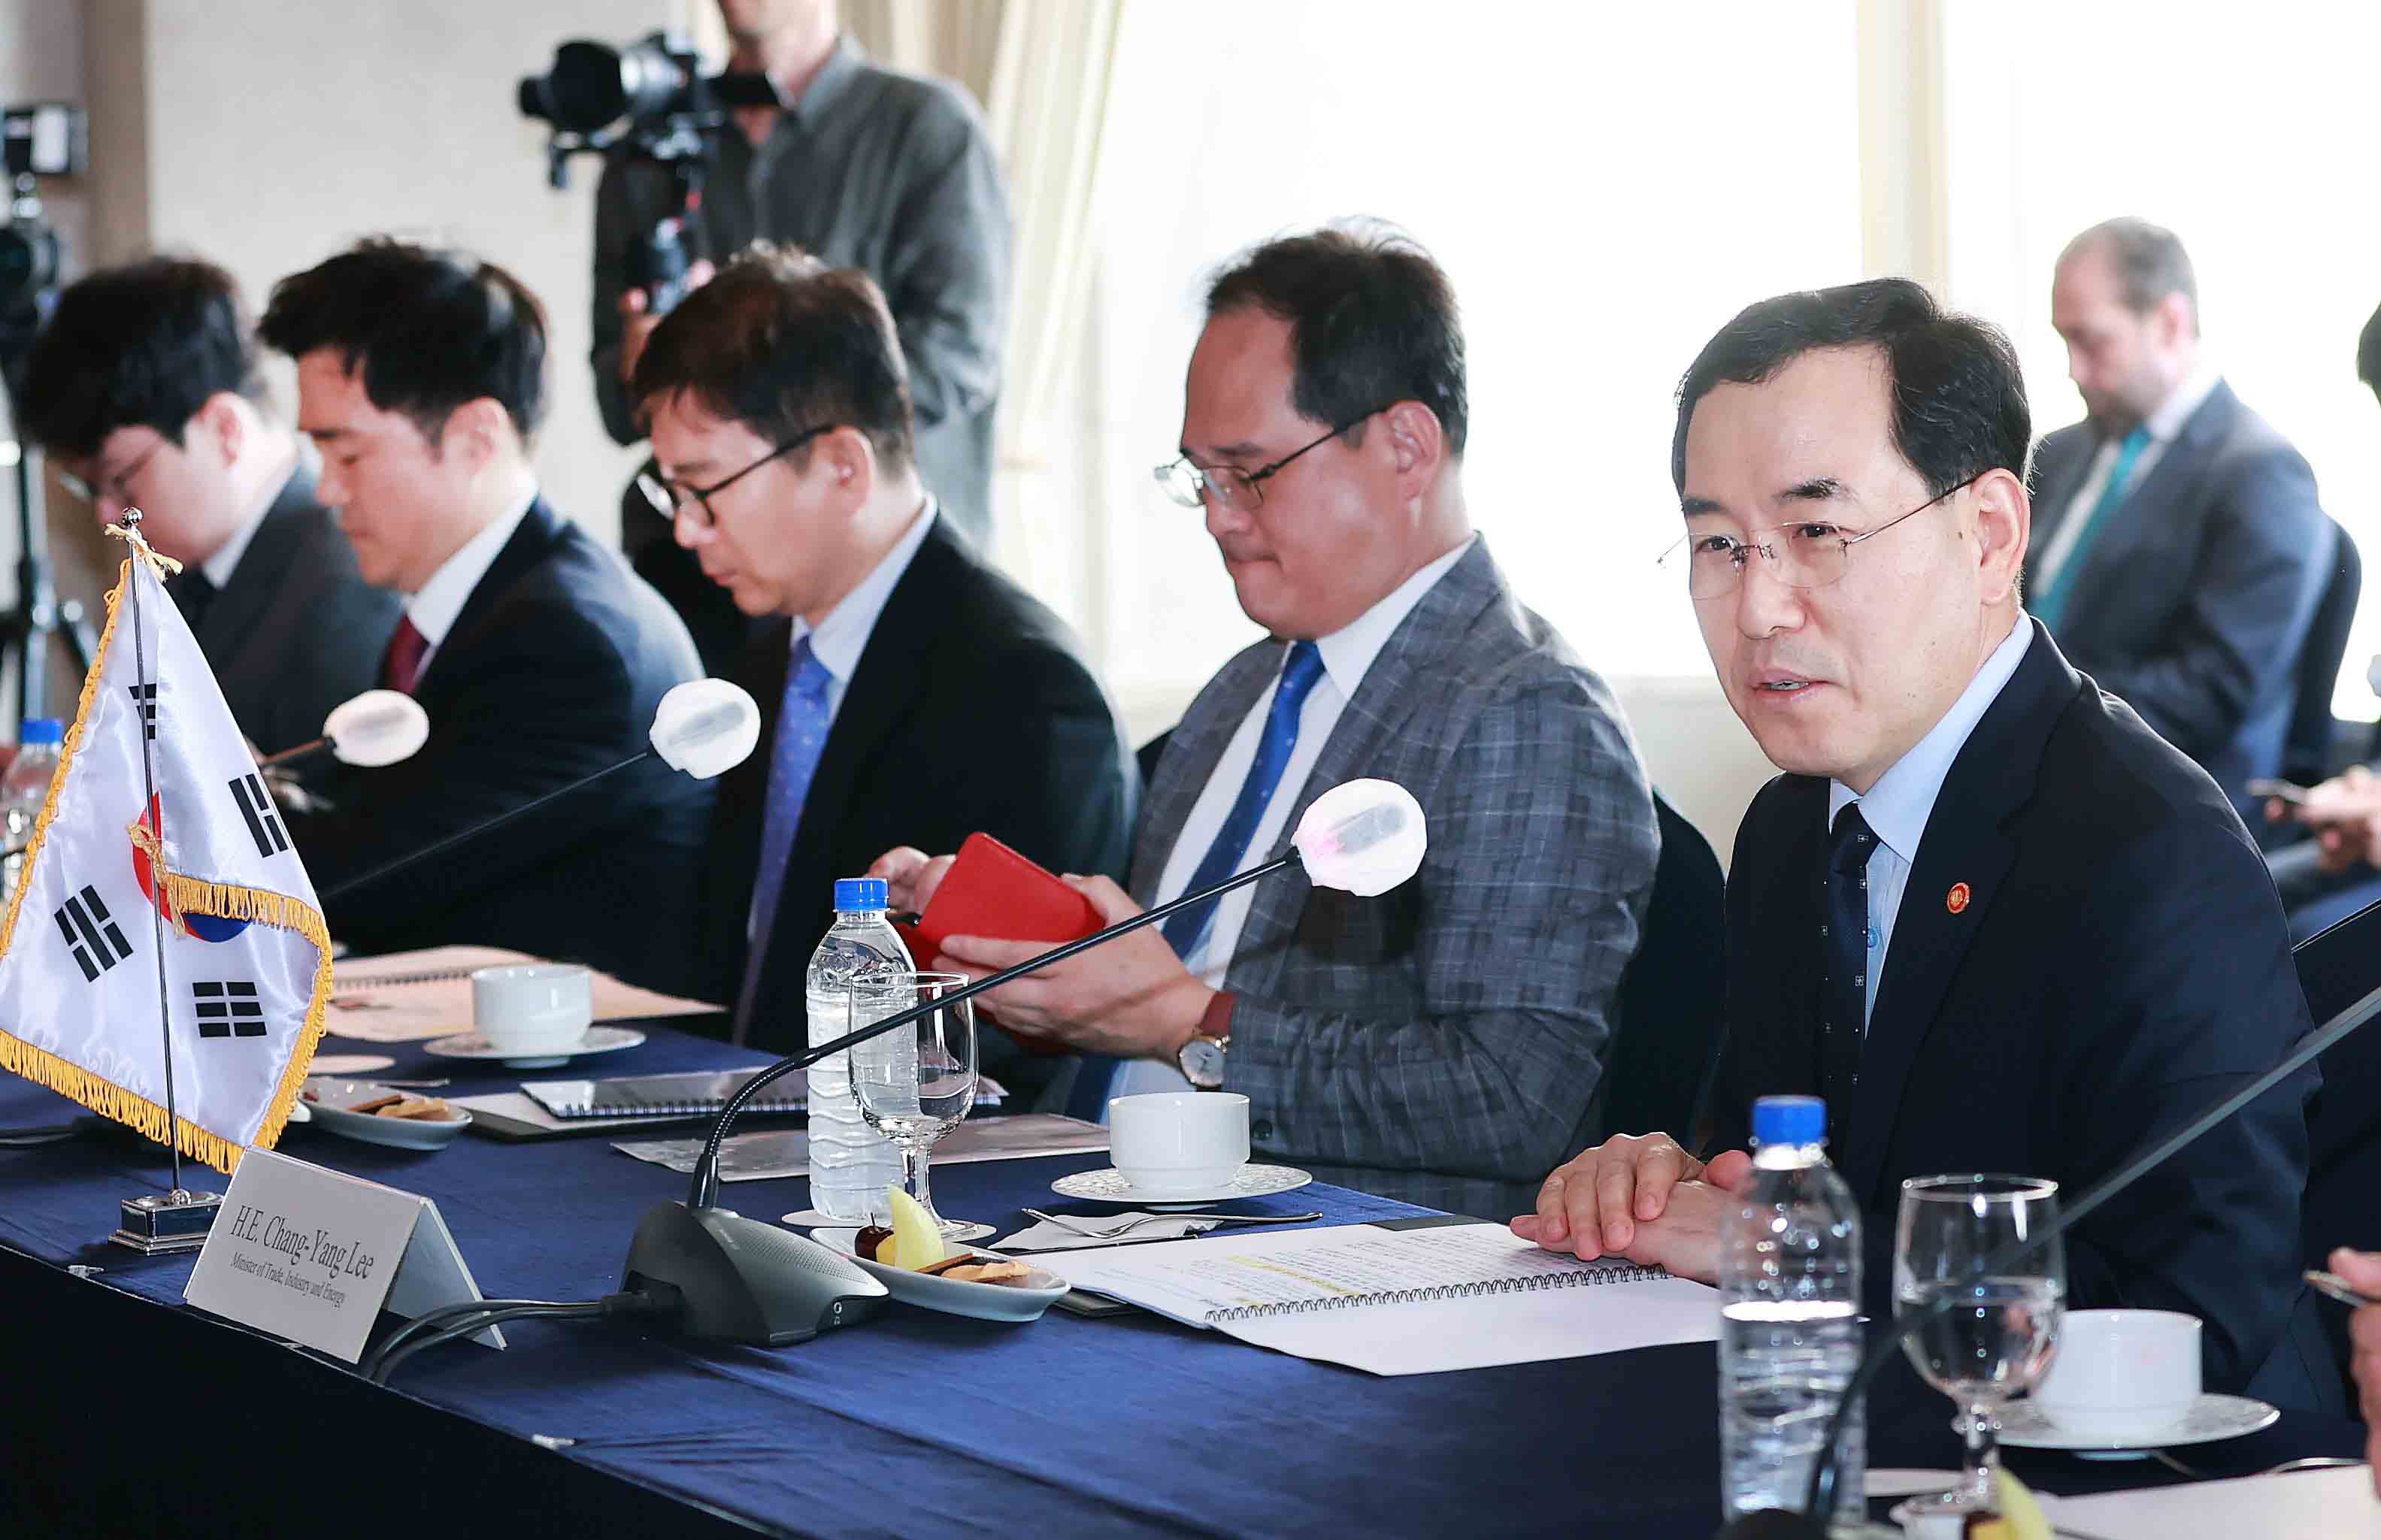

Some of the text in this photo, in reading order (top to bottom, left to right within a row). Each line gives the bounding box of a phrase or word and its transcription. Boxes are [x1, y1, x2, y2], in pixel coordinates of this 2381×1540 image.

[230, 1205, 374, 1279] H.E. Chang-Yang Lee
